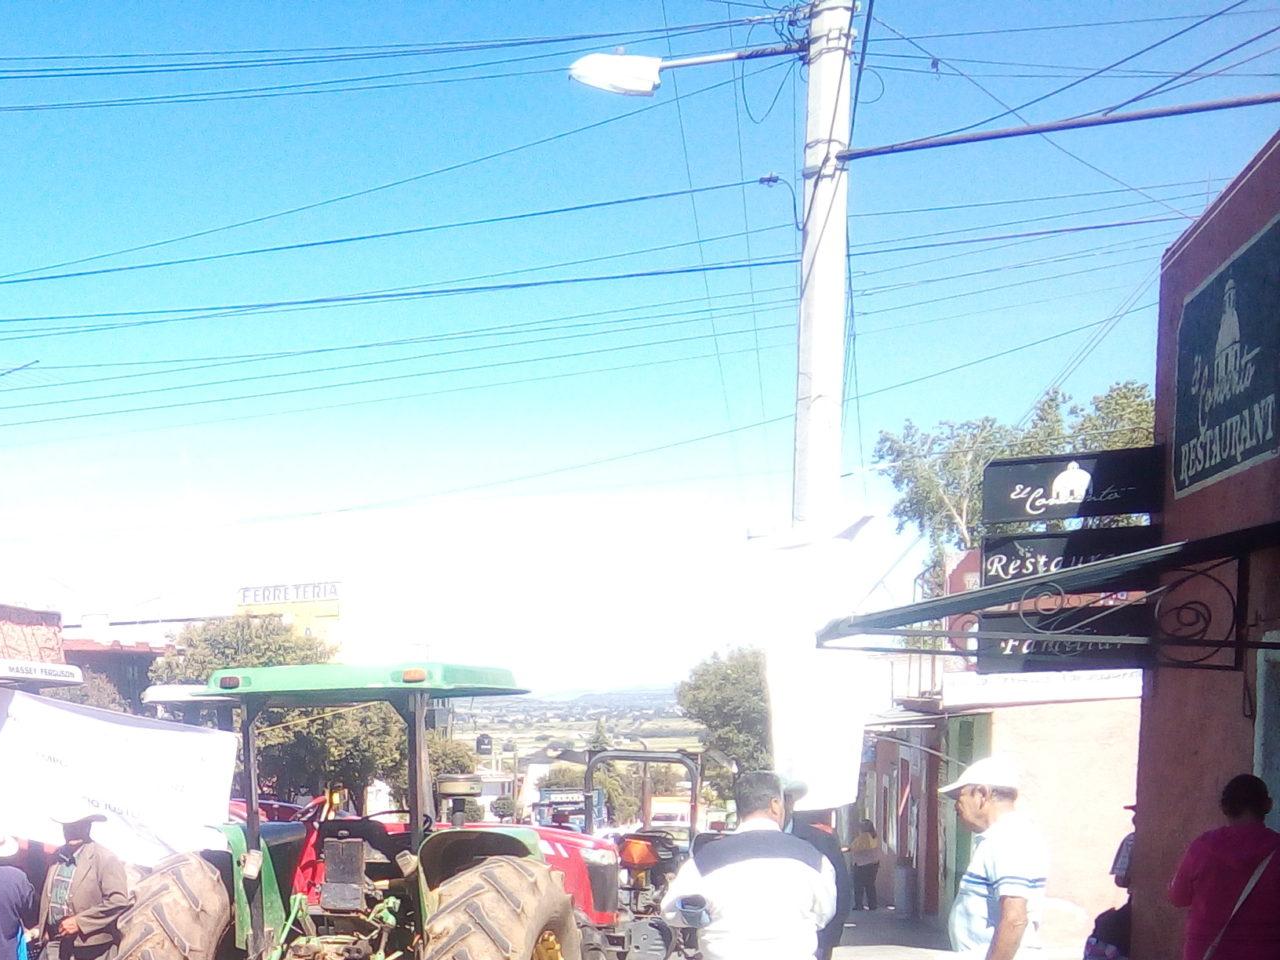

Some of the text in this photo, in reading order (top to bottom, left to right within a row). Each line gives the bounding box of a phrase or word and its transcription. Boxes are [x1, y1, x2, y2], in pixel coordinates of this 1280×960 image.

[1179, 393, 1275, 486] RESTAURANT
[241, 584, 339, 604] FERRETERIA
[8, 666, 75, 679] MASSEY FERGUSON
